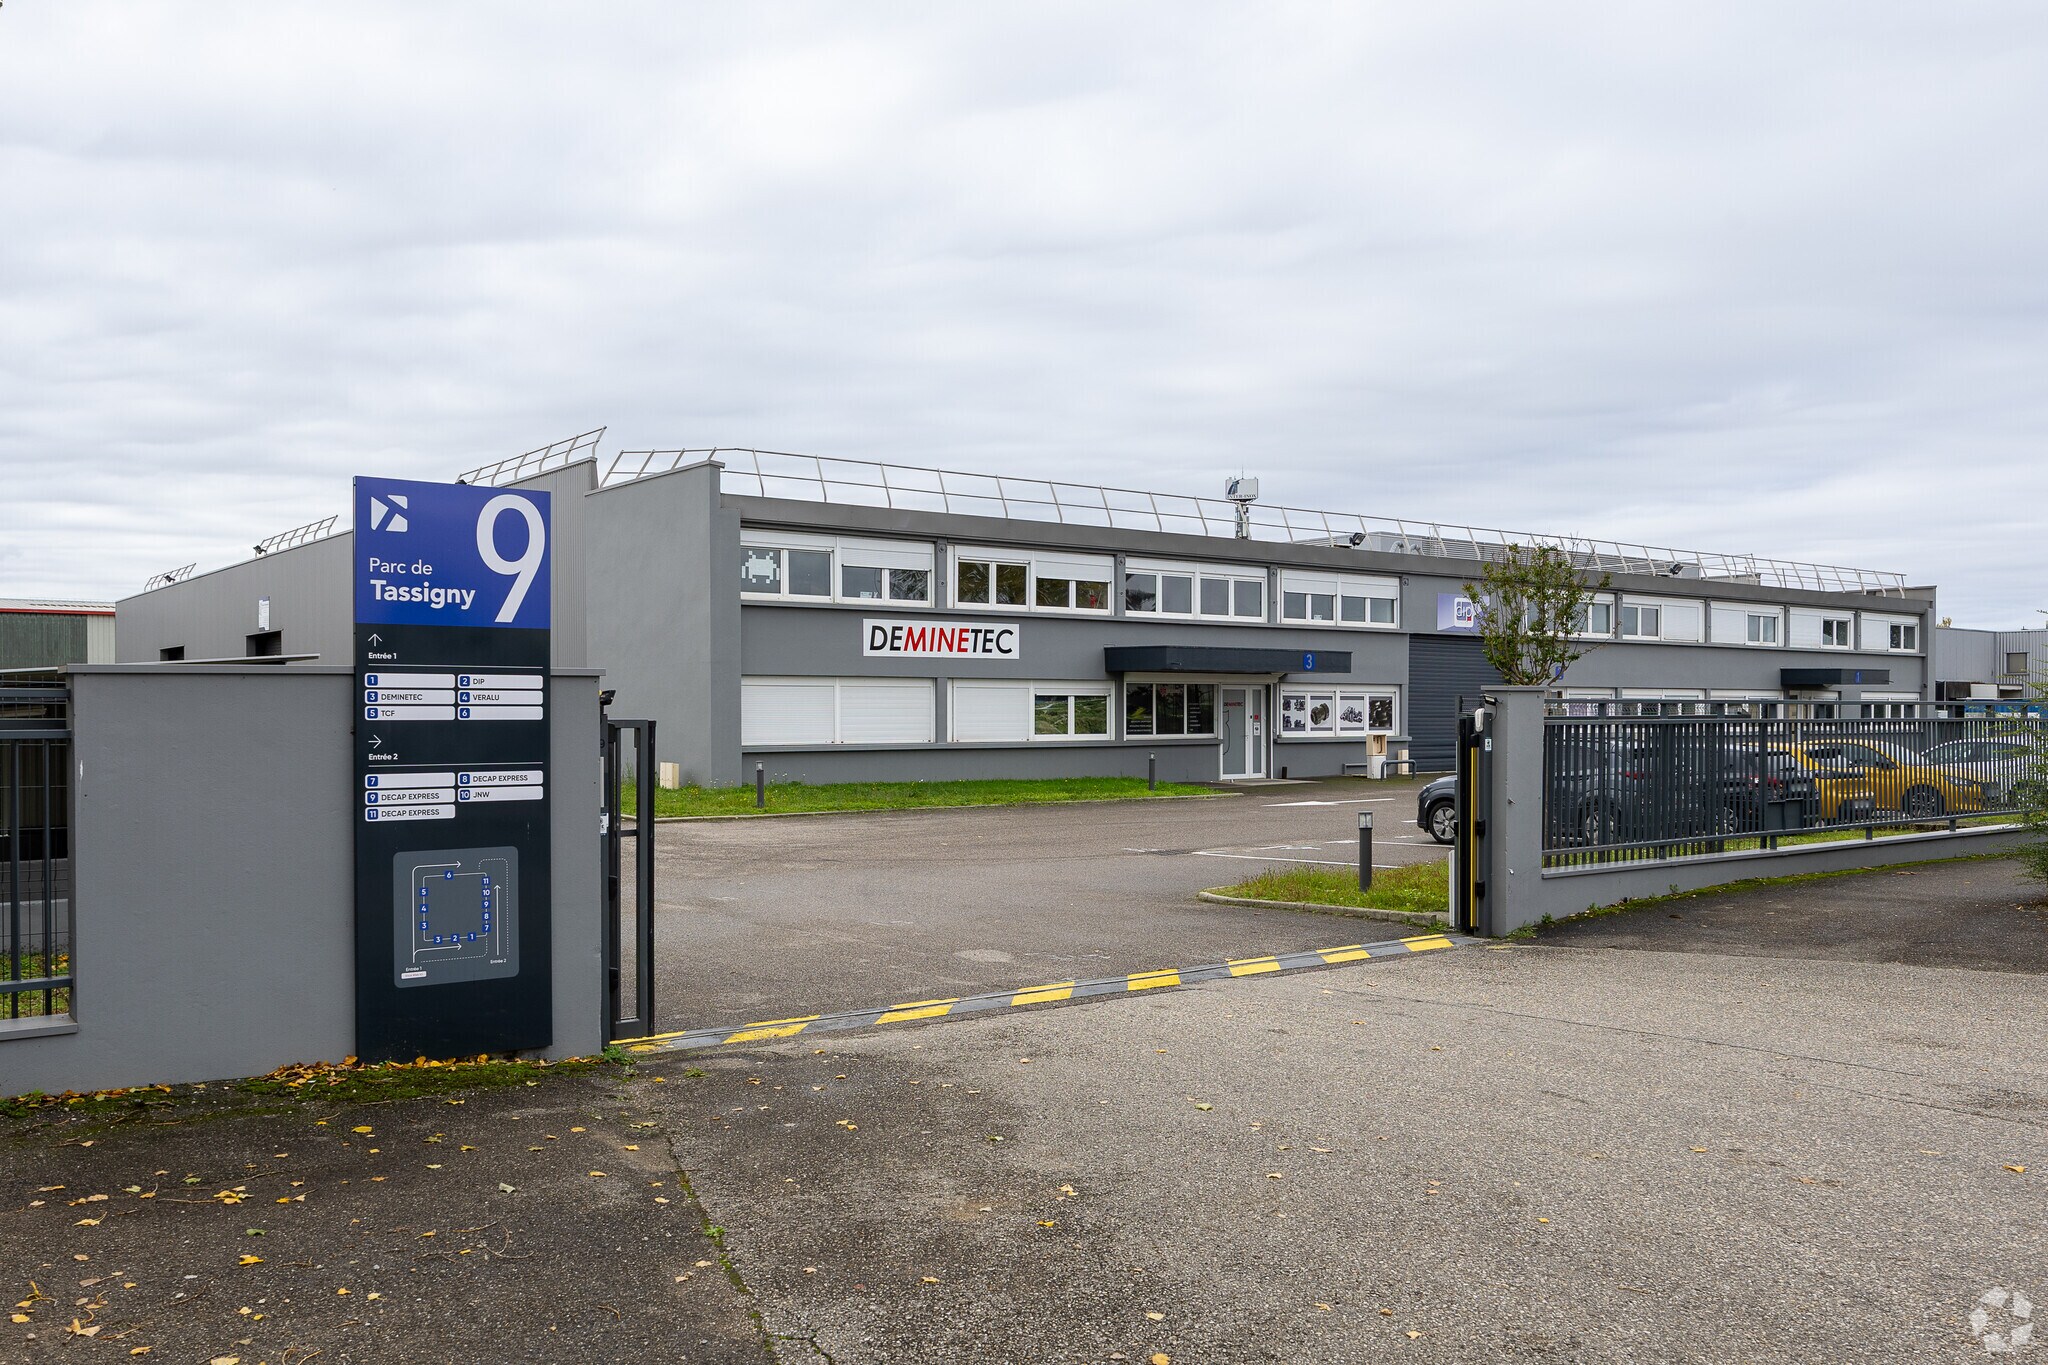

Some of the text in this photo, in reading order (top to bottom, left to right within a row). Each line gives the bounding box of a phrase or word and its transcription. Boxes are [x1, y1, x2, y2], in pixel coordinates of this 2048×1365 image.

[476, 494, 546, 623] 9
[369, 557, 433, 575] Parc de
[369, 579, 476, 610] Tassigny
[869, 625, 1014, 655] DEMINETEC
[368, 651, 392, 660] Entrée
[1306, 654, 1313, 669] 3
[381, 693, 423, 701] DEMINETEC
[462, 693, 468, 701] 4
[368, 753, 392, 761] Entrée
[473, 775, 497, 783] DECAP
[460, 791, 469, 799] 10
[369, 810, 377, 818] 11
